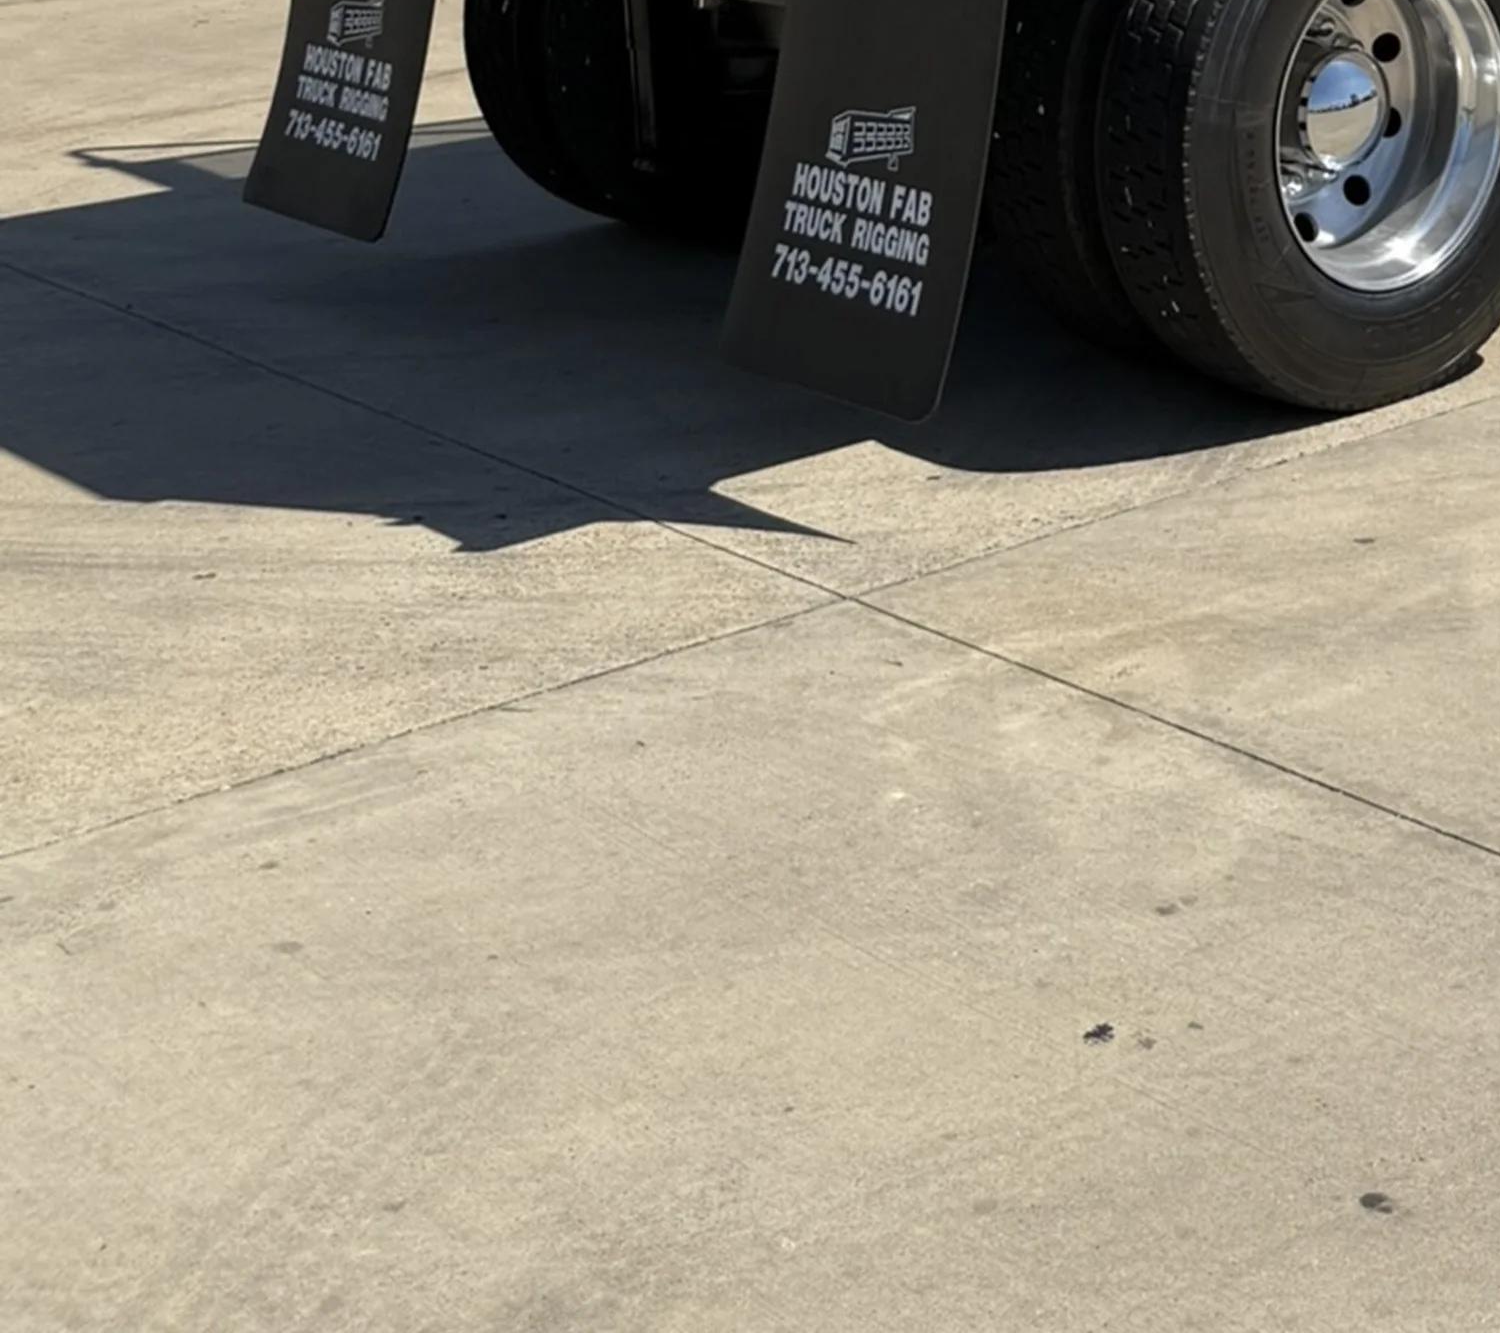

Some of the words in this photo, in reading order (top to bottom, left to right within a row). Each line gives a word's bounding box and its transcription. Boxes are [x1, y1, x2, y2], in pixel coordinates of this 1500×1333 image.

[303, 43, 364, 83] HOUSTON
[364, 58, 392, 91] FAB
[296, 75, 338, 107] TRUCK
[339, 86, 389, 122] RIGGING
[285, 109, 381, 161] 713-455-6161
[793, 163, 885, 215] HOUSTON
[890, 185, 932, 226] FAB
[784, 201, 846, 244] TRUCK
[851, 218, 930, 266] RIGGING
[772, 243, 922, 316] 713-455-6161
